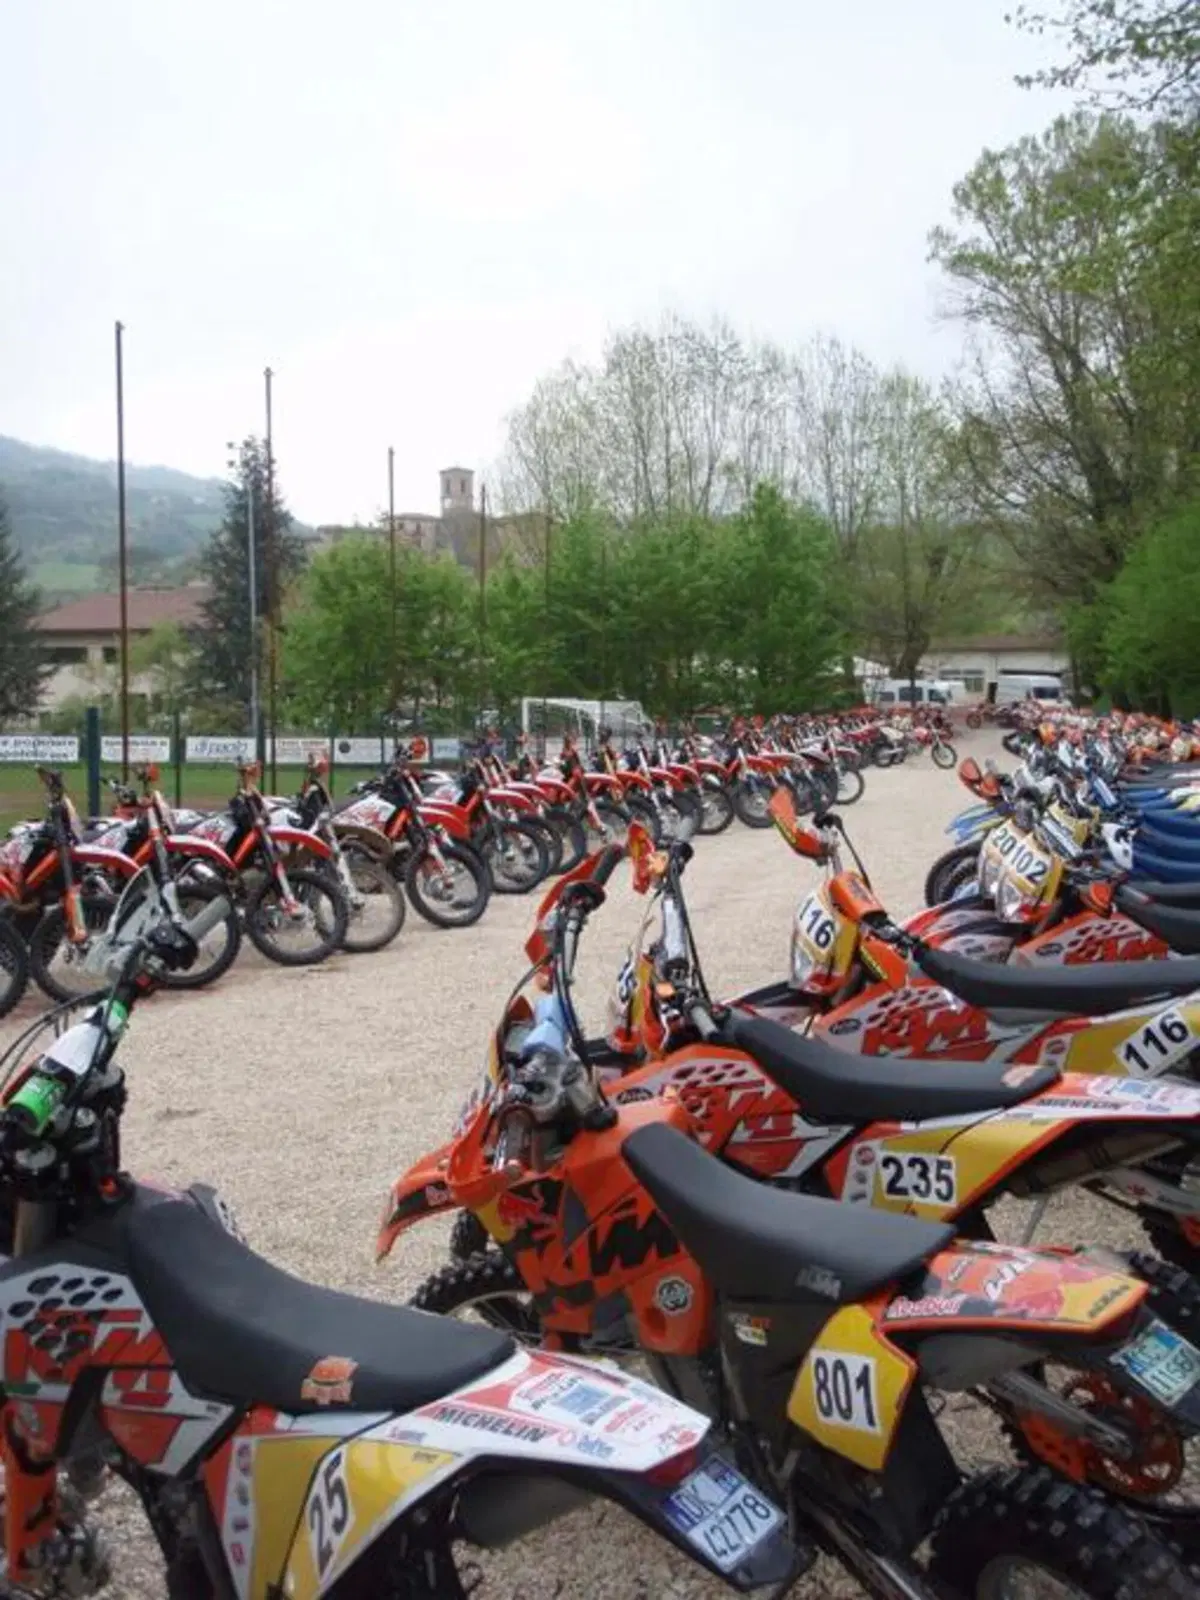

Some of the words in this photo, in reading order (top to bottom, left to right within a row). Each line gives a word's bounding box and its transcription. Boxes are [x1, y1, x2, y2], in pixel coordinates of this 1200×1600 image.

[1124, 1013, 1189, 1071] 116
[881, 1155, 954, 1202] 235
[814, 1356, 876, 1427] 801
[434, 1404, 549, 1444] MICHELIN
[309, 1450, 350, 1577] 25
